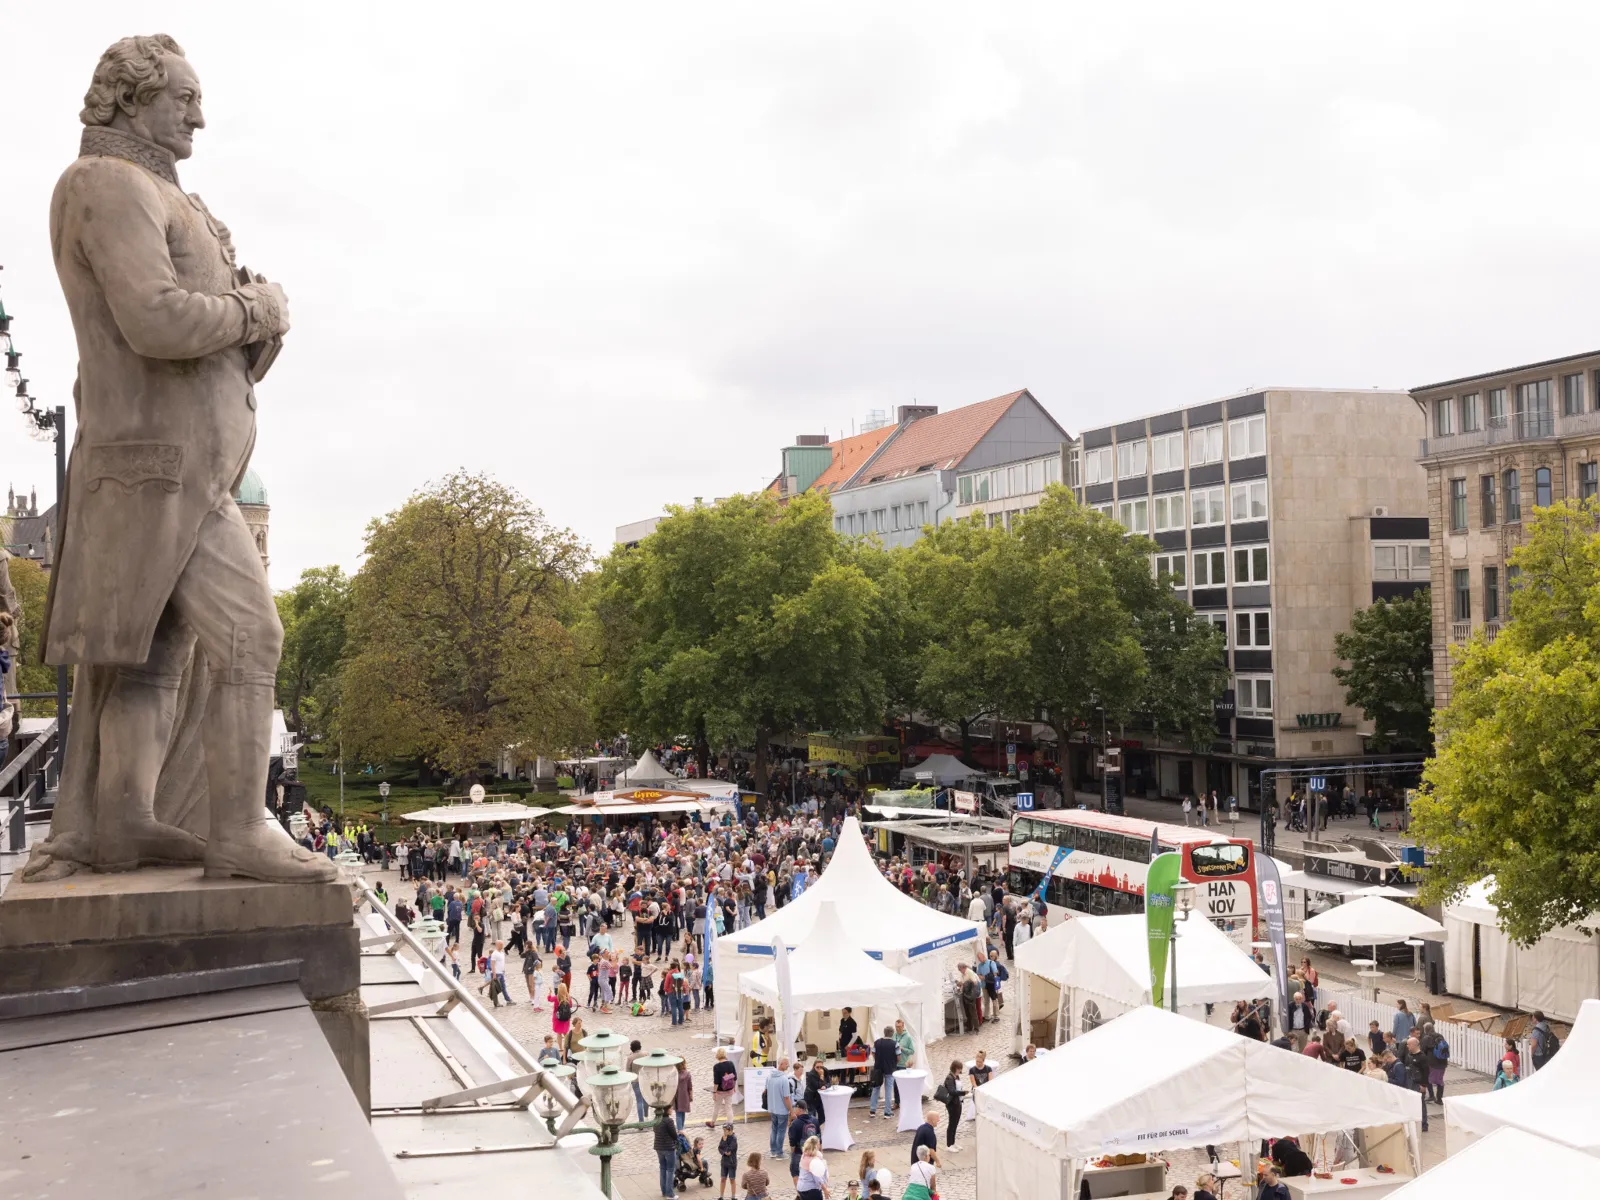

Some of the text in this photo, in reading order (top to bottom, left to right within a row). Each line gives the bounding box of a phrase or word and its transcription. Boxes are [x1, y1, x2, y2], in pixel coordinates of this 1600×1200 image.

[1296, 713, 1342, 728] WEITZ
[1317, 778, 1326, 790] U
[634, 791, 660, 801] Gyros
[1024, 795, 1033, 808] U
[1327, 860, 1356, 879] FoodMafia
[1208, 881, 1236, 897] HAN
[1208, 899, 1236, 914] NOV
[1209, 918, 1226, 932] R
[1137, 1133, 1146, 1141] FIT
[1159, 1130, 1168, 1138] DIE
